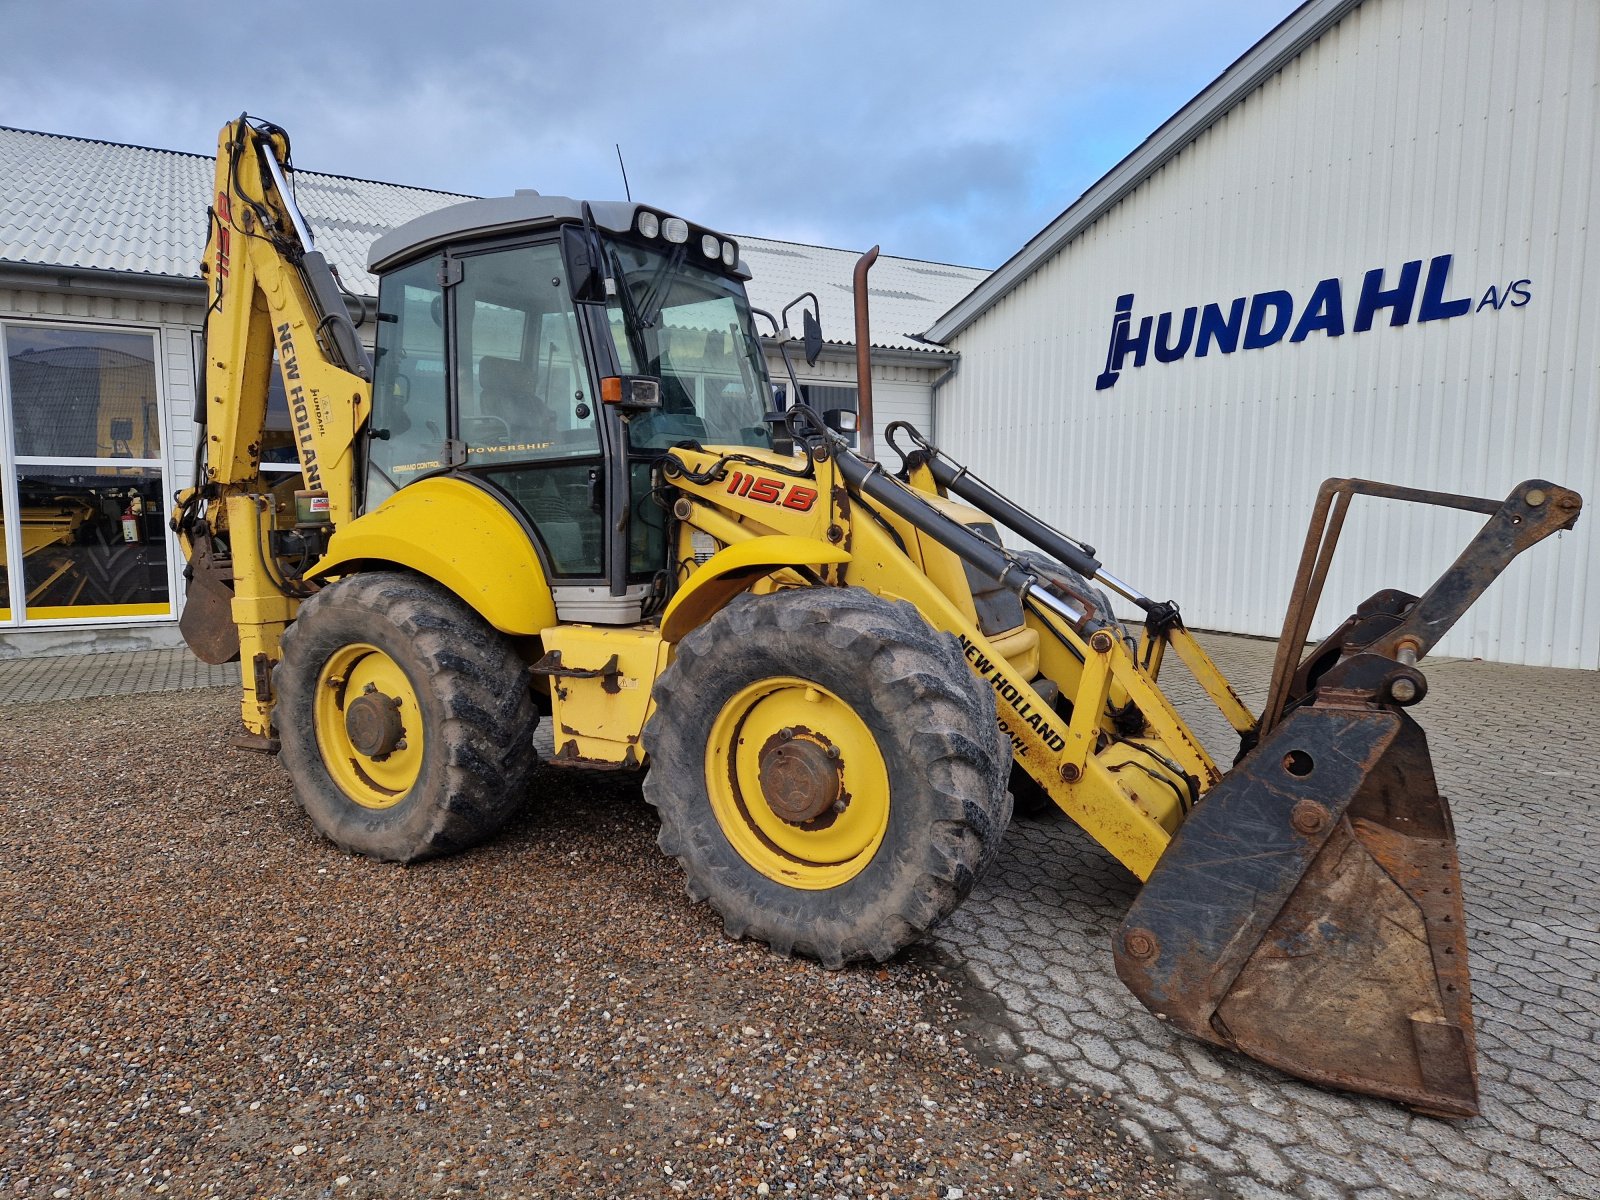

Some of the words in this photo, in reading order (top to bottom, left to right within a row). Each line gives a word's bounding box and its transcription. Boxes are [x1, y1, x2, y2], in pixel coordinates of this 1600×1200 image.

[1476, 279, 1531, 312] A/S
[277, 322, 300, 380] NEW
[959, 634, 995, 675] NEW
[990, 672, 1066, 752] HOLLAND
